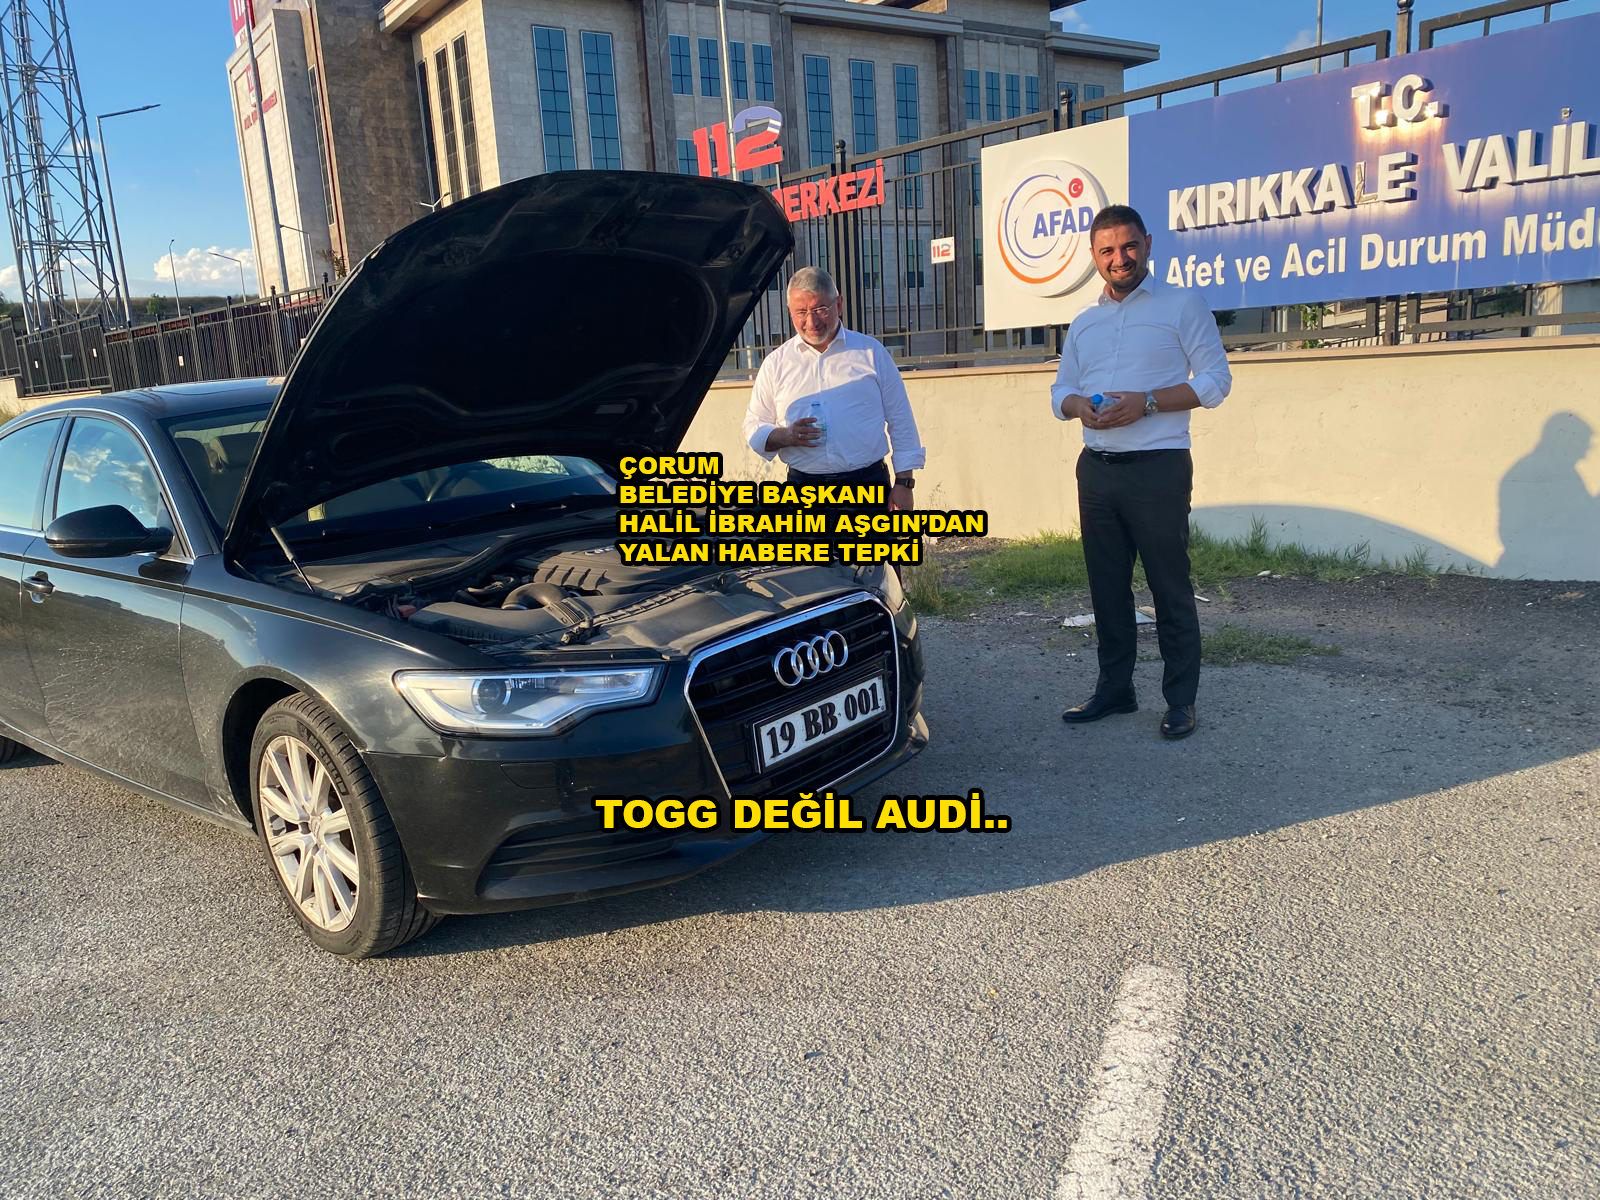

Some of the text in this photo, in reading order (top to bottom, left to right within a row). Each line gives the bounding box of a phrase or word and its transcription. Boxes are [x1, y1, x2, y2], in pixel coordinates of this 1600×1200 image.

[1352, 74, 1441, 129] T.C.
[693, 106, 784, 177] 112
[1032, 206, 1093, 238] AFAD
[1168, 151, 1415, 231] KIRIKKALE
[933, 244, 951, 258] 112
[1166, 253, 1225, 288] Afet
[1235, 254, 1271, 283] ve
[1281, 237, 1347, 279] Acil
[1360, 229, 1487, 270] Durum
[1503, 207, 1600, 256] Müd
[767, 682, 880, 759] 19 BB 001
